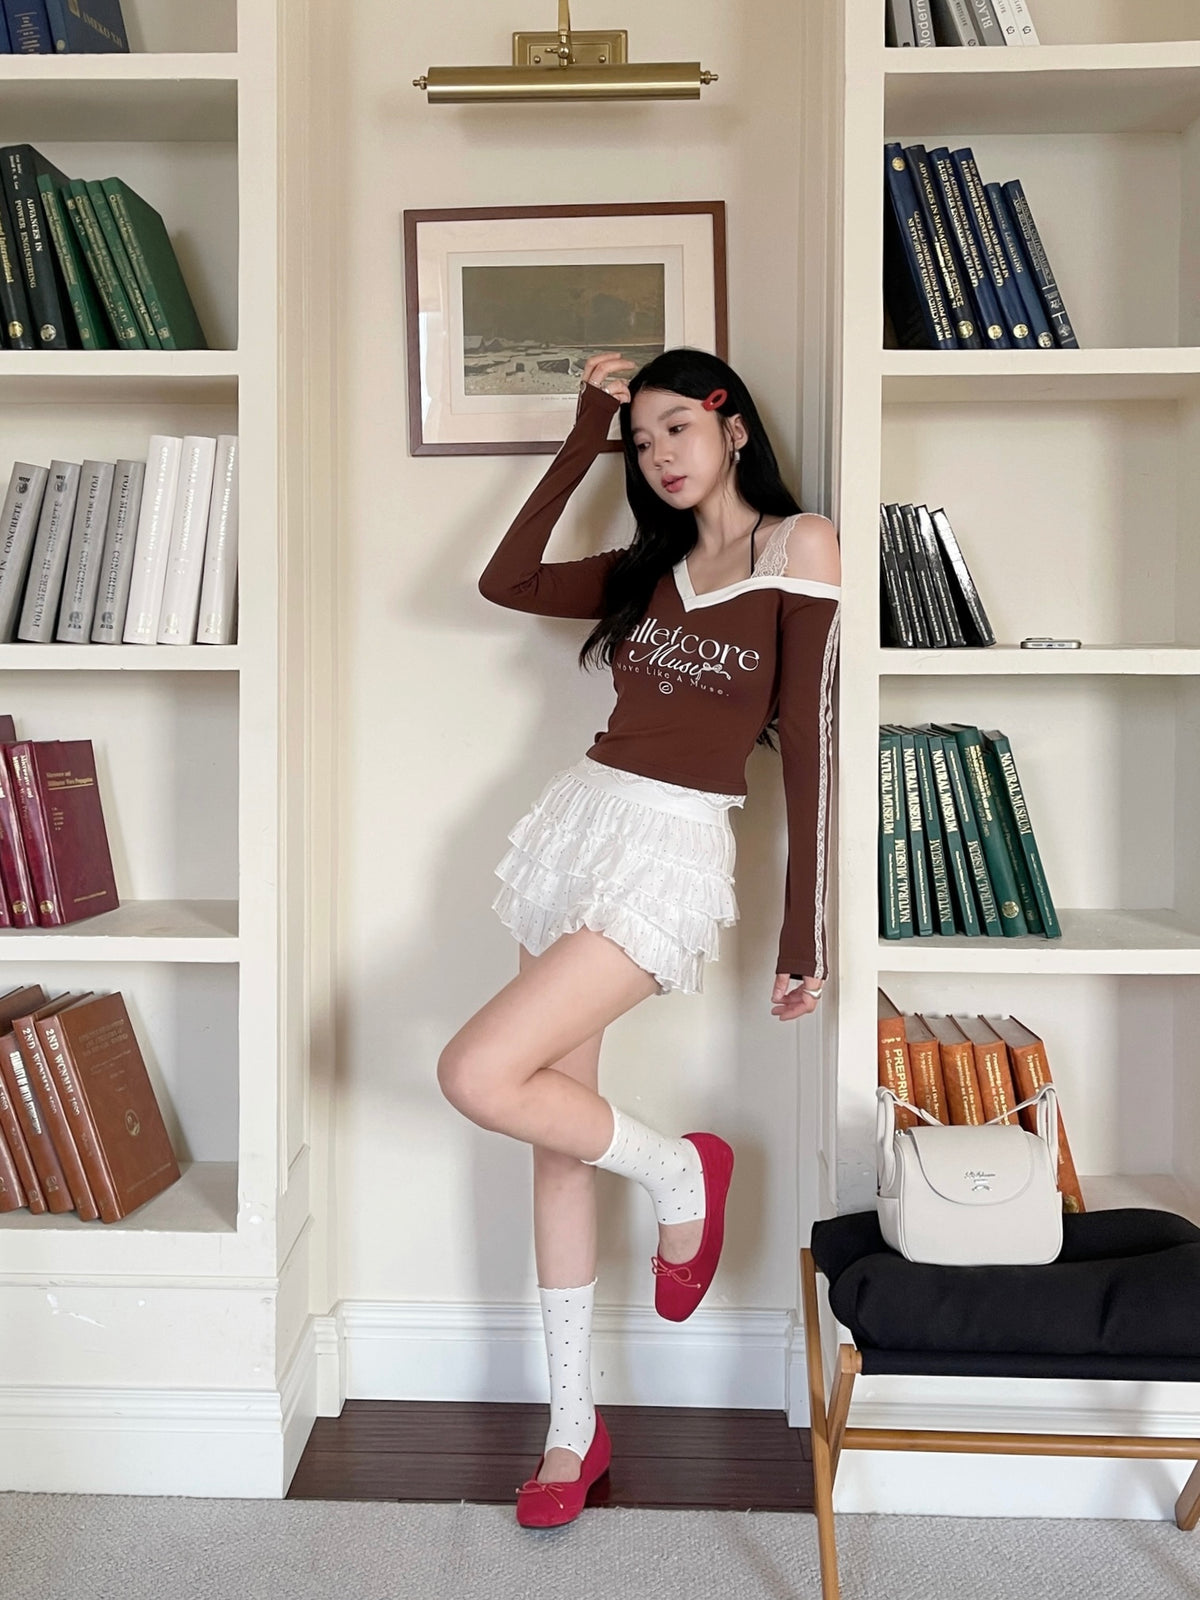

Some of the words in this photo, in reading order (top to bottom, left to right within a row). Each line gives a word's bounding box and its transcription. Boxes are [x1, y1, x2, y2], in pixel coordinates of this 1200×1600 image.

[919, 162, 936, 204] ADVANCES
[26, 198, 40, 239] ADVANCES
[35, 242, 42, 251] IN
[908, 218, 914, 226] IN
[930, 204, 938, 214] IN
[937, 160, 948, 181] FLUID
[944, 182, 956, 208] POWER
[950, 208, 968, 255] ENGINEERING
[961, 160, 972, 181] FLUID
[968, 182, 980, 208] POWER
[975, 208, 994, 255] ENGINEERING
[15, 200, 25, 229] POWER
[20, 232, 36, 288] ENGINEERING
[917, 253, 925, 268] AND
[933, 215, 955, 271] MANAGEMENT
[966, 230, 974, 244] AND
[978, 270, 984, 278] IN
[990, 230, 998, 244] AND
[1002, 270, 1009, 278] IN
[1004, 232, 1023, 273] LEARNING
[922, 243, 939, 290] ENGINEERING
[934, 292, 946, 316] POWER
[947, 272, 964, 307] SCIENCE
[941, 317, 952, 338] FLUID
[85, 475, 99, 529] POLYMERS
[116, 474, 129, 528] POLYMERS
[4, 502, 22, 554] CONCRETE
[46, 500, 62, 552] CONCRETE
[83, 532, 88, 543] IN
[114, 532, 122, 544] IN
[42, 558, 51, 570] IN
[73, 550, 88, 603] CONCRETE
[105, 550, 120, 603] CONCRETE
[32, 573, 49, 627] POLYMERS
[625, 617, 760, 672] alletcore
[629, 641, 702, 677] Muse
[646, 667, 670, 680] Like
[677, 675, 683, 683] A
[880, 750, 892, 793] NATURAL
[903, 748, 917, 791] NATURAL
[932, 750, 950, 793] NATURAL
[882, 794, 894, 834] MUSEUM
[908, 791, 921, 831] MUSEUM
[940, 792, 957, 832] MUSEUM
[999, 752, 1020, 795] NATURAL
[1010, 794, 1031, 835] MUSEUM
[894, 839, 907, 878] MUSEUM
[929, 839, 945, 879] MUSEUM
[967, 840, 986, 880] MUSEUM
[897, 879, 910, 922] NATURAL
[935, 879, 951, 922] NATURAL
[978, 880, 996, 923] NATURAL
[22, 1028, 36, 1049] 2ND
[46, 1028, 59, 1050] 2ND
[886, 1058, 894, 1080] Control
